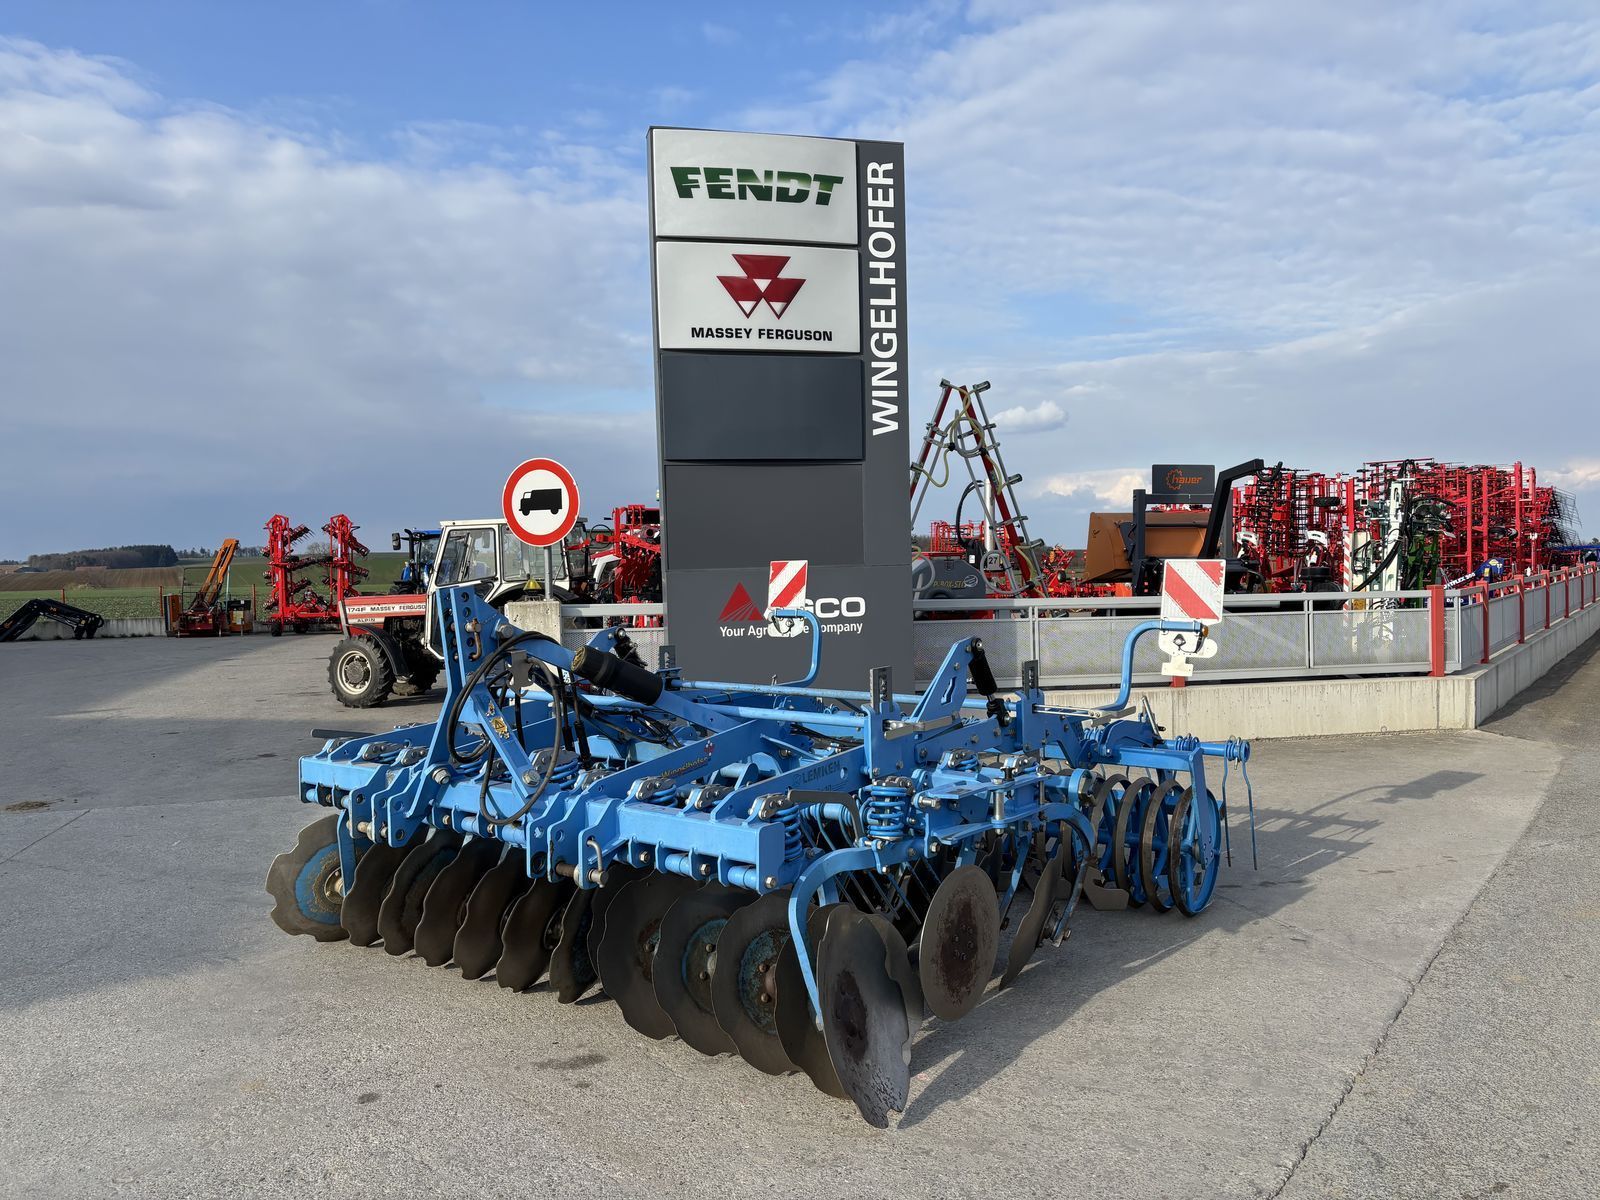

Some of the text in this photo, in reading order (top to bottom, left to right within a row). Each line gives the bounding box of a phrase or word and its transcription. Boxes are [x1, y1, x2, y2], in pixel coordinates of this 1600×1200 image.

[670, 166, 845, 206] FENDT
[866, 161, 899, 437] WINGELHOFER
[691, 327, 833, 341] MASSEY FERGUSON
[988, 557, 998, 565] 27
[719, 625, 745, 637] Your
[821, 622, 863, 635] ompany
[802, 761, 840, 784] LEMKEN
